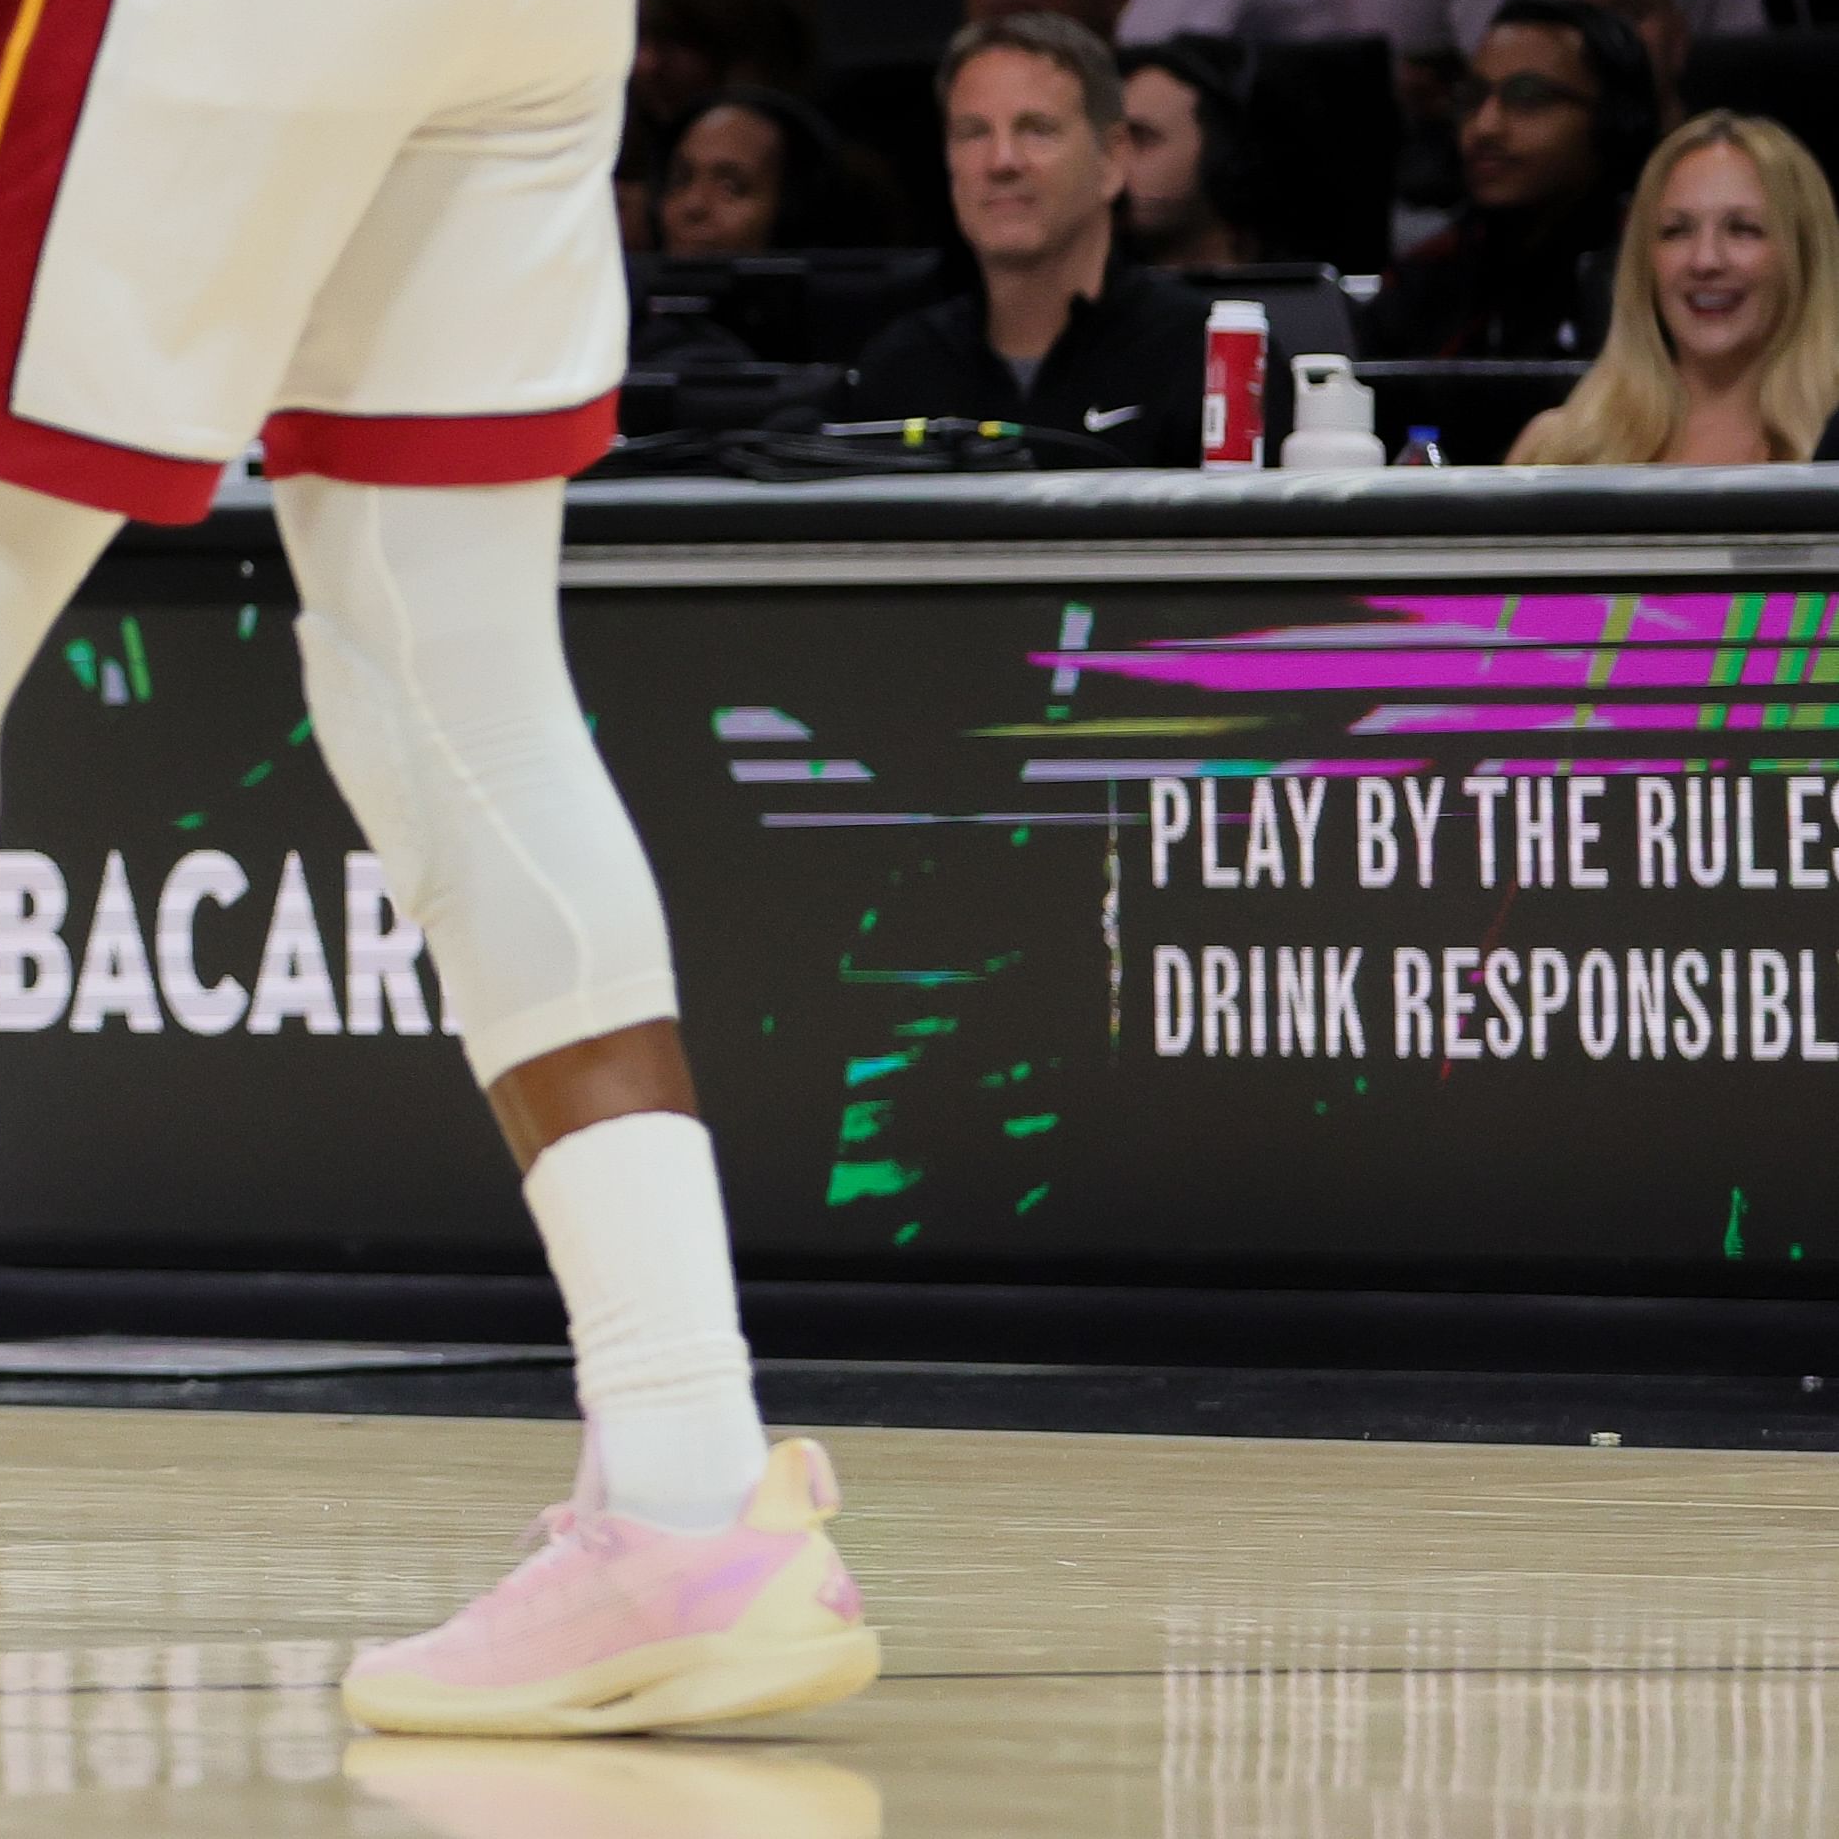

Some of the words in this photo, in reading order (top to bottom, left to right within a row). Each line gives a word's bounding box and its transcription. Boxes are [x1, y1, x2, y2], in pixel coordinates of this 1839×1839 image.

[1149, 775, 1327, 890] PLAY
[1355, 775, 1445, 890] BY
[1462, 775, 1611, 890] THE
[1636, 775, 1839, 892] RULE
[1152, 944, 1367, 1059] DRINK
[1393, 946, 1839, 1062] RESPONSIBL
